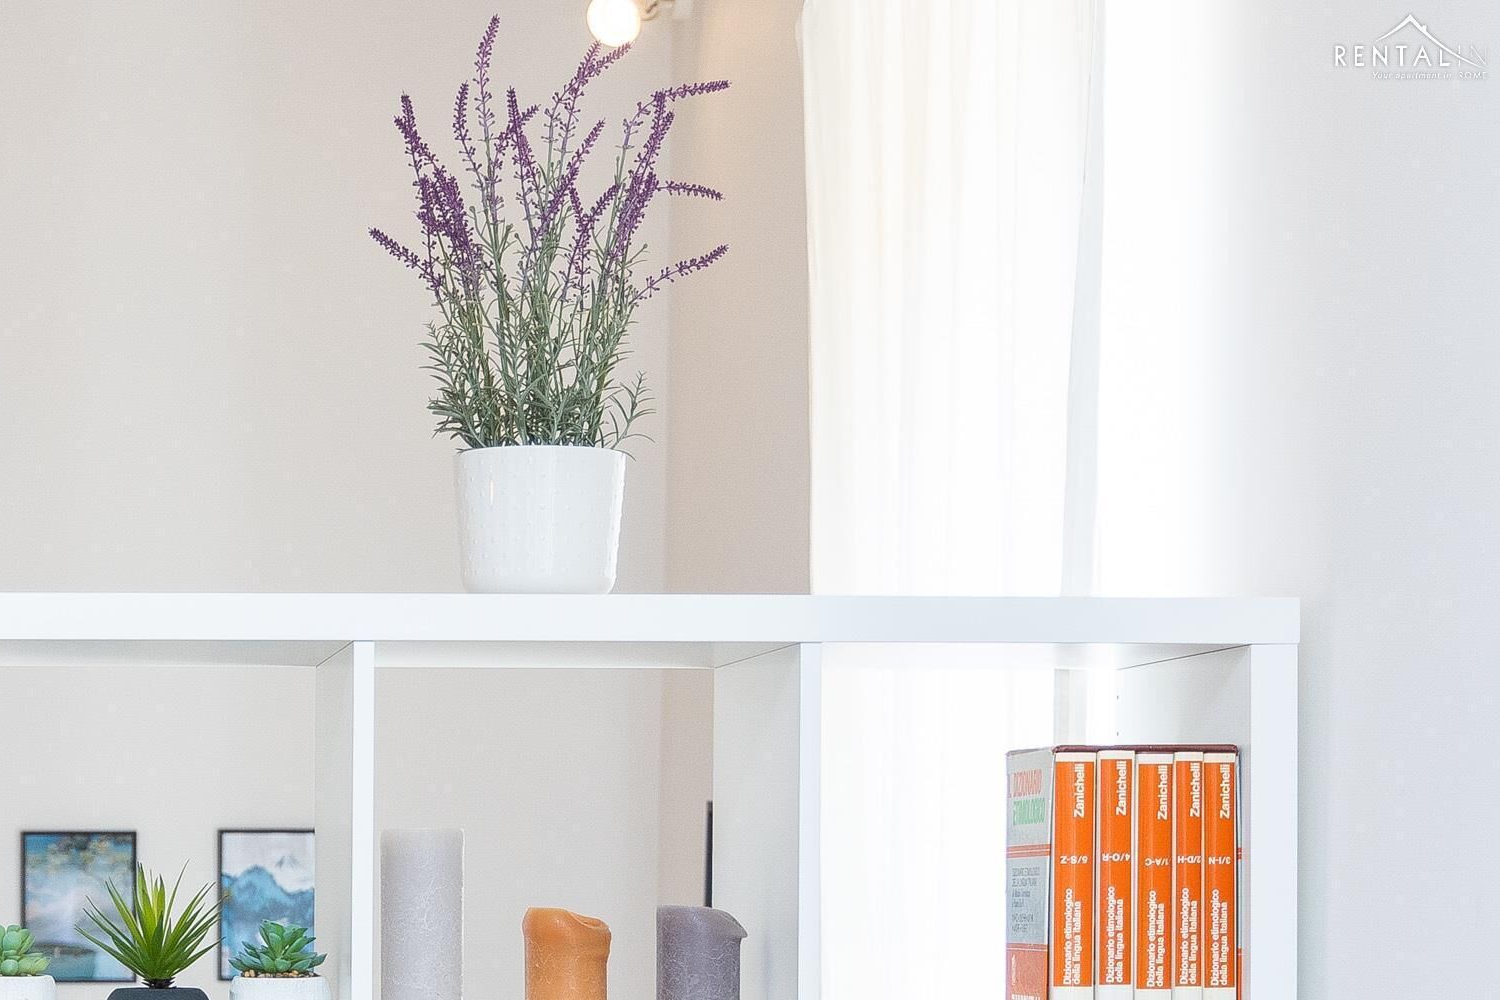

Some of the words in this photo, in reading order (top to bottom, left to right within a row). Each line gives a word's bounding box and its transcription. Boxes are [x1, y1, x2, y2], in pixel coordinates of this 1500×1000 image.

[1074, 763, 1085, 818] Zanichelli
[1116, 760, 1127, 816] Zanichelli
[1157, 765, 1168, 820] Zanichelli
[1190, 762, 1200, 817] Zanichelli
[1220, 764, 1230, 819] Zanichelli
[1064, 888, 1074, 939] etimologico
[1073, 901, 1081, 934] italiana
[1106, 886, 1116, 937] etimologico
[1115, 899, 1123, 931] italiana
[1147, 890, 1157, 942] etimologico
[1156, 903, 1164, 935] italiana
[1180, 888, 1190, 939] etimologico
[1189, 900, 1197, 933] italiana
[1211, 889, 1220, 940] etimologico
[1220, 902, 1228, 934] italiana
[1063, 940, 1073, 985] Dizionario
[1073, 934, 1082, 962] lingua
[1106, 938, 1114, 983] Dizionario
[1115, 933, 1124, 960] lingua
[1147, 943, 1155, 987] Dizionario
[1156, 936, 1165, 964] lingua
[1180, 940, 1188, 985] Dizionario
[1189, 934, 1198, 962] lingua
[1211, 941, 1219, 986] Dizionario
[1220, 935, 1229, 963] lingua
[1073, 963, 1081, 985] della
[1115, 962, 1123, 983] della
[1156, 965, 1164, 987] della
[1189, 963, 1197, 985] della
